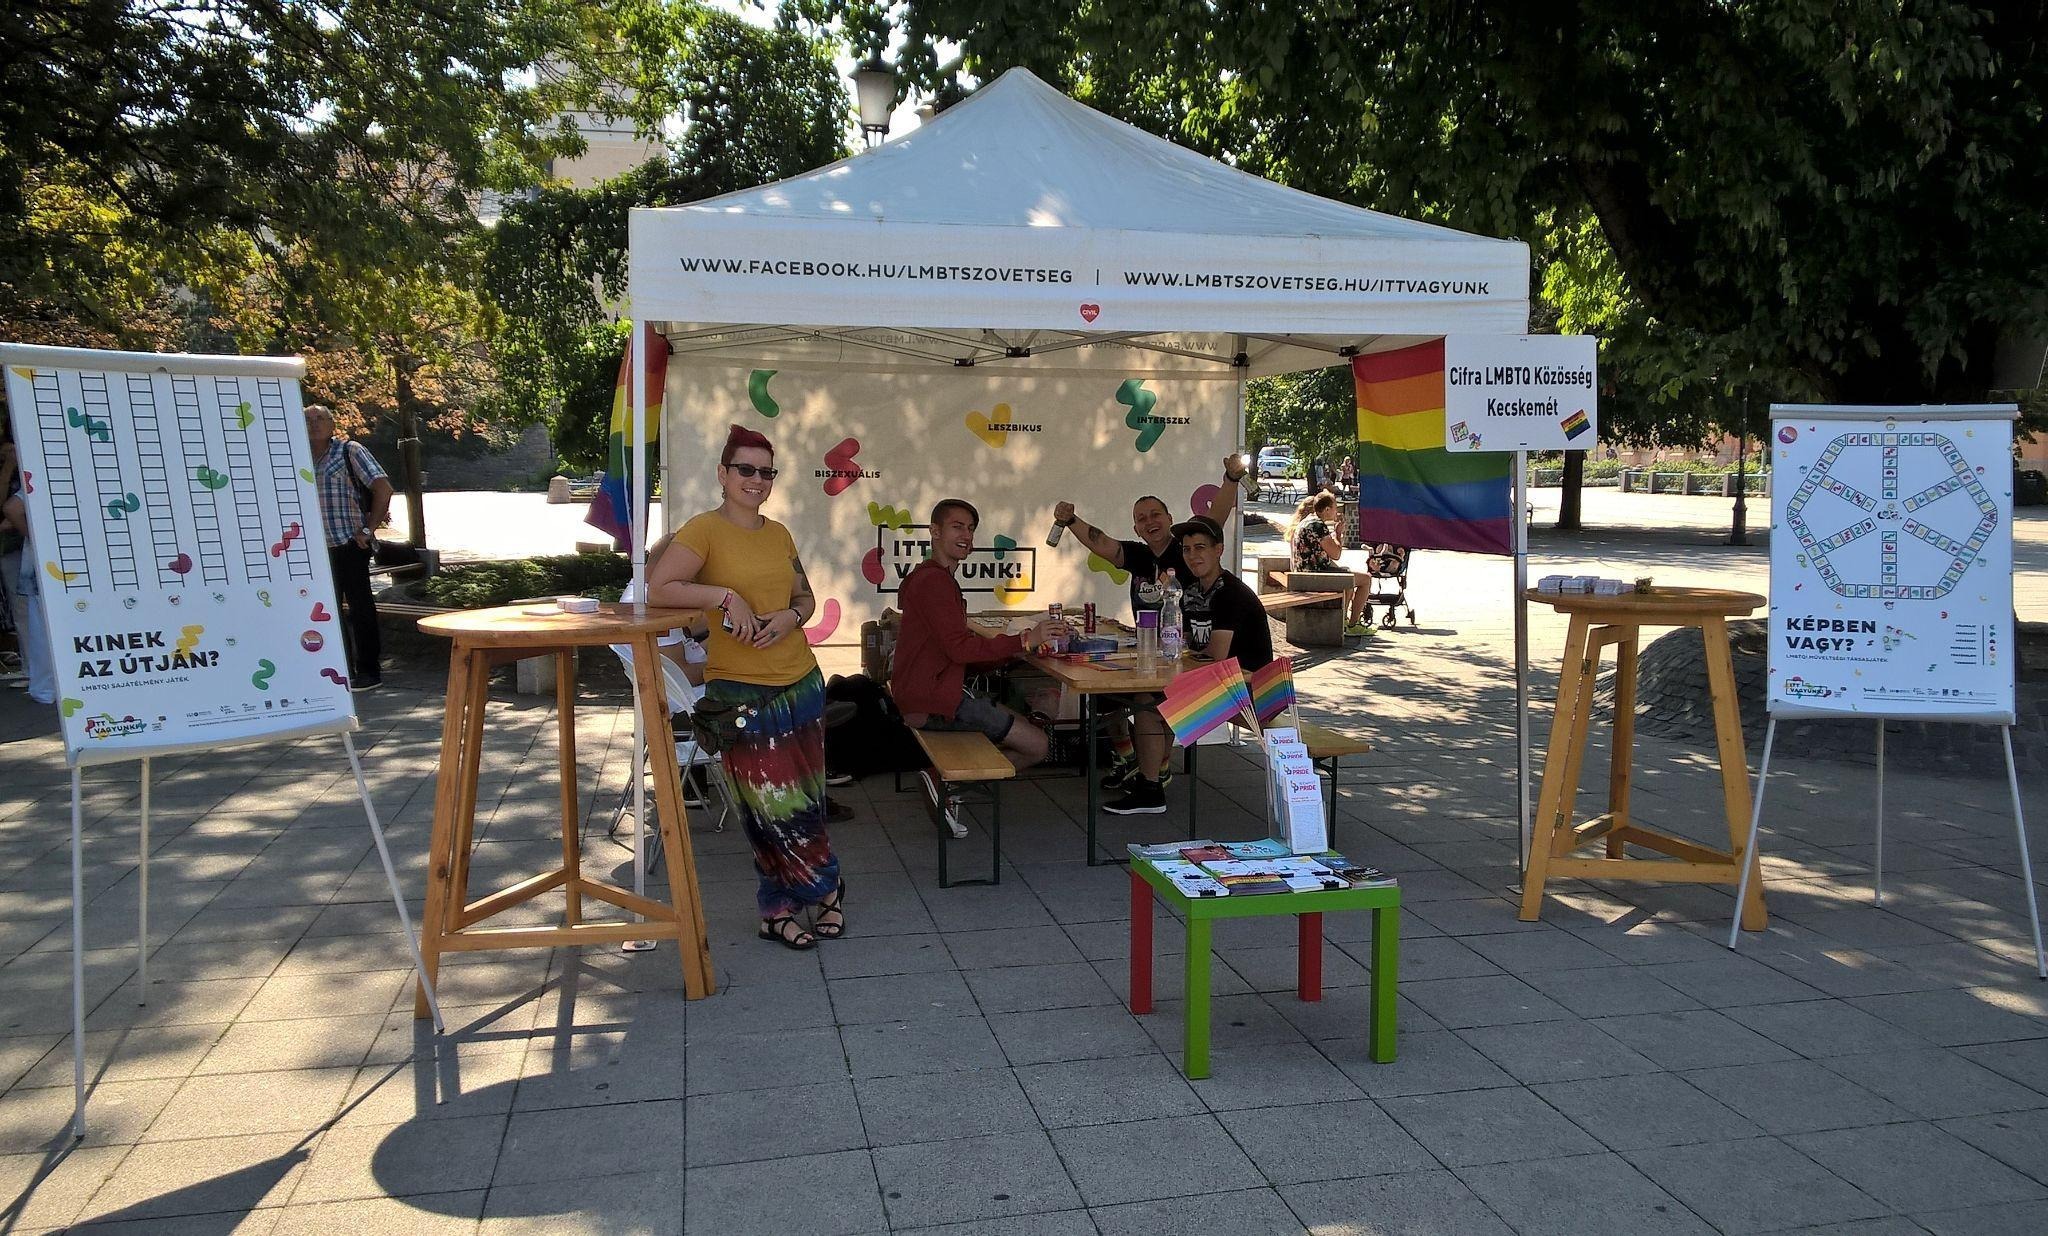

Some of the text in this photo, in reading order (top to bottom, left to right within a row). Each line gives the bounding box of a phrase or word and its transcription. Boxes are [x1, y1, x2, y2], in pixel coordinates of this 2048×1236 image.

[680, 257, 1073, 283] WWW.FACEBOOK.HU/LMBTSZOVETSEG
[1124, 271, 1490, 295] WWW.LMBTSZOVETSEG.HU/ITTVAGYUNK
[1450, 365, 1592, 389] Cifra LMBTQ Közösség
[1487, 396, 1559, 417] Kecskemét
[988, 423, 1042, 431] LESZBIKUS
[1137, 416, 1190, 424] INTERSZEX
[814, 468, 881, 478] BISZEXUÁLIS
[893, 540, 931, 556] ITT
[893, 562, 1022, 579] VUNK!
[1786, 615, 1876, 633] KÉPBEN
[73, 631, 165, 653] KINEK
[1785, 636, 1855, 652] VAGY?
[78, 649, 220, 678] AZ ÚTJÁN?
[165, 676, 189, 684] JÁTÉK
